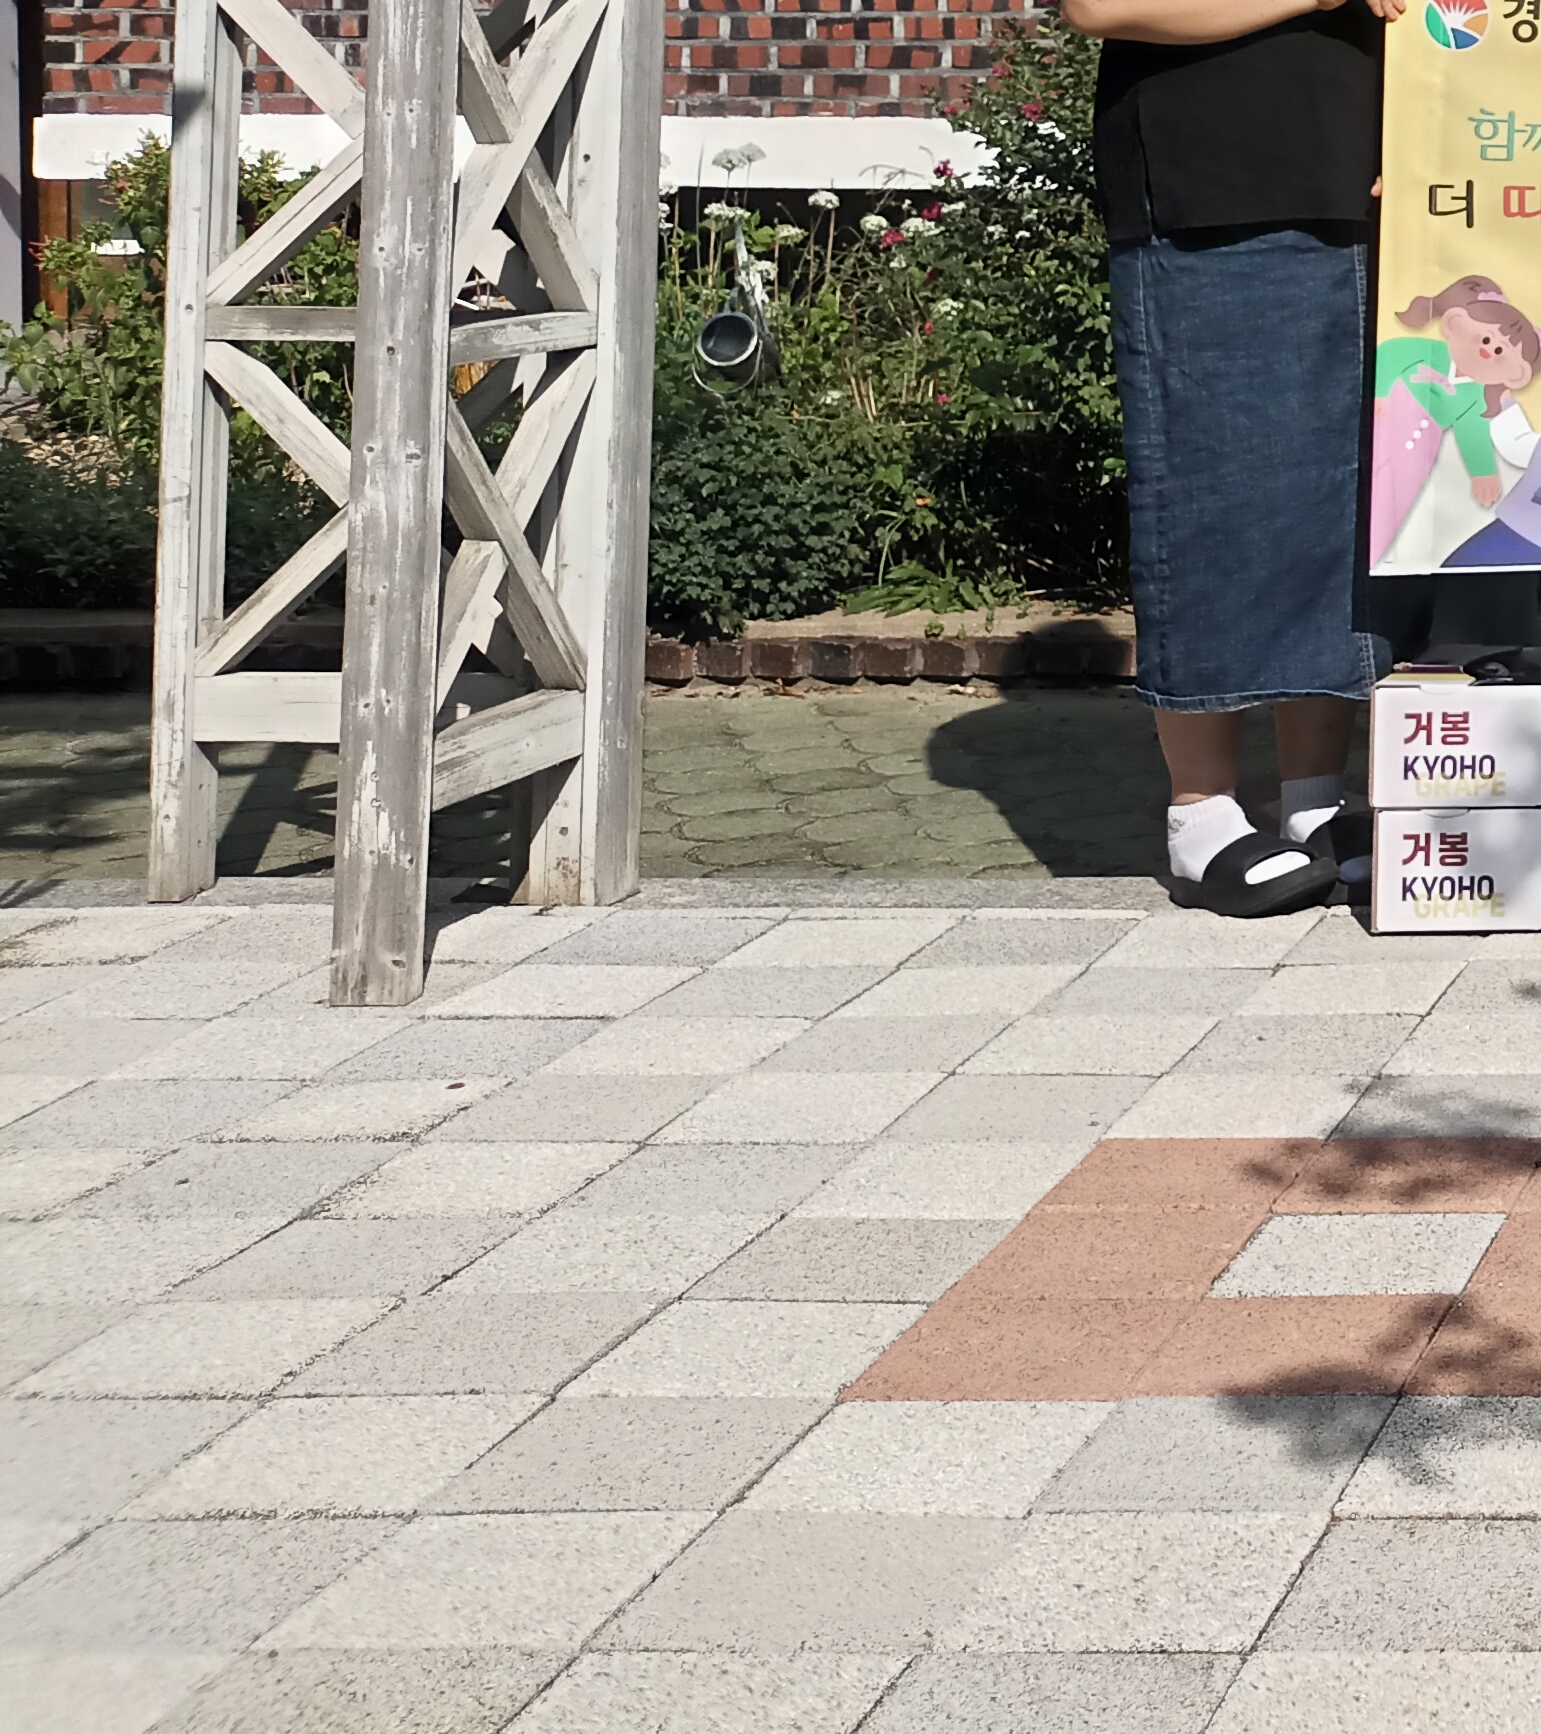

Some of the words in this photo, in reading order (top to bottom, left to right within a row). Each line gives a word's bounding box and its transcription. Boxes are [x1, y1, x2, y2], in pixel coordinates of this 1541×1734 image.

[1427, 179, 1475, 229] 더
[1402, 710, 1471, 746] 거봉
[1402, 754, 1496, 780] KYOHO
[1414, 771, 1507, 798] GRAPE
[1401, 831, 1470, 867] 거봉
[1400, 875, 1495, 902] KYOHO
[1413, 892, 1506, 919] GRAPE
